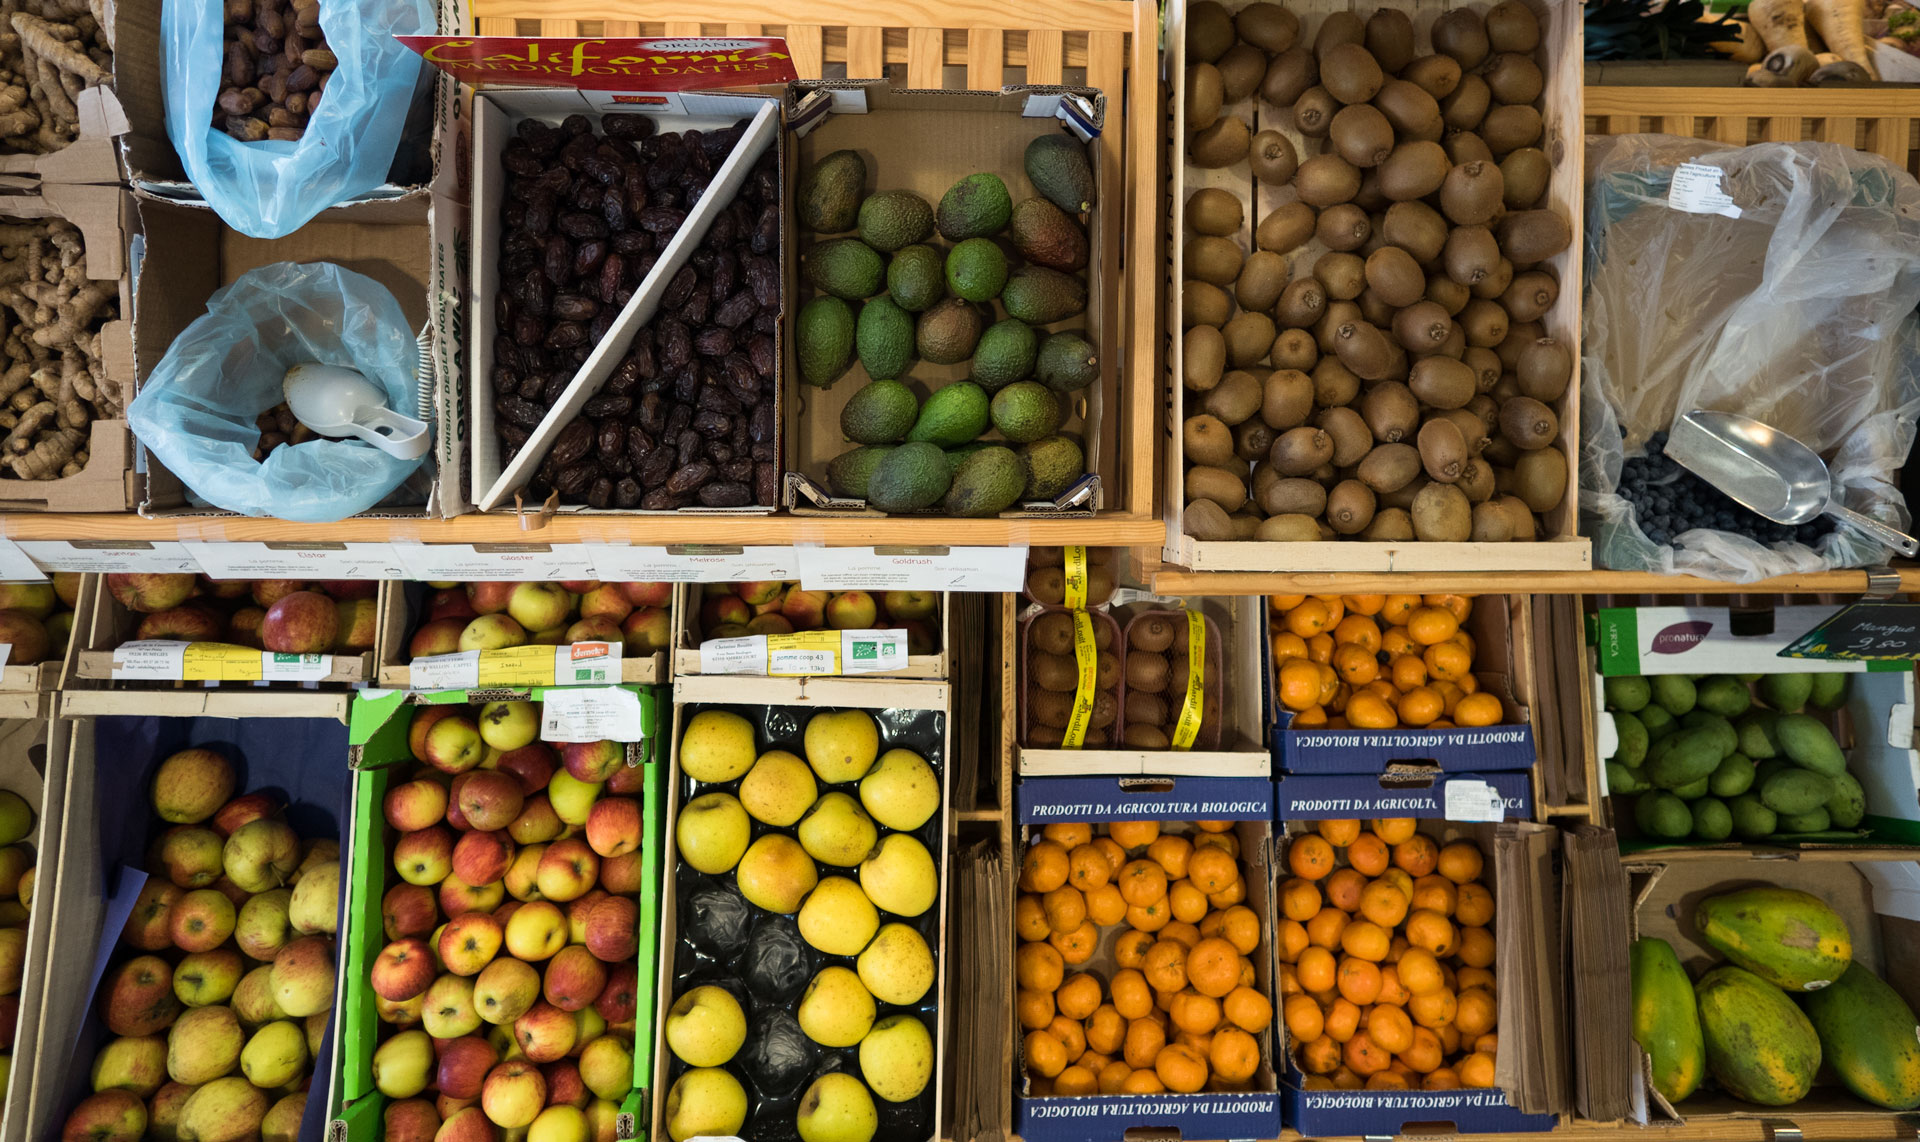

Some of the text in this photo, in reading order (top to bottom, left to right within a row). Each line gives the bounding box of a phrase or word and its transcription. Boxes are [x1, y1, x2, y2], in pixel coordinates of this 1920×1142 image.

[653, 40, 750, 49] ORGANIC
[423, 41, 790, 77] California
[651, 62, 769, 75] DATES
[440, 339, 450, 395] DEGLET
[452, 286, 464, 441] ORGANIC
[1165, 331, 1173, 440] KIWI
[1852, 623, 1916, 636] Mangue
[1609, 622, 1619, 656] AFRICA
[1659, 633, 1705, 643] pronatura
[574, 647, 605, 657] demeter
[1296, 731, 1526, 747] PRODOTTI DA AGRICOLTURA BIOLOGICA
[1032, 801, 1268, 816] PRODOTTI DA AGRICOLTURA BIOLOGICA
[1290, 798, 1438, 811] PRODOTTI DA AGRICOLT
[1305, 1096, 1373, 1109] BIOLOGICA
[1377, 1095, 1463, 1108] AGRICOLTURA
[1466, 1094, 1482, 1106] DA
[1030, 1101, 1274, 1118] PRODOTTI DA AGRICOLTURA BIOLOGICA
